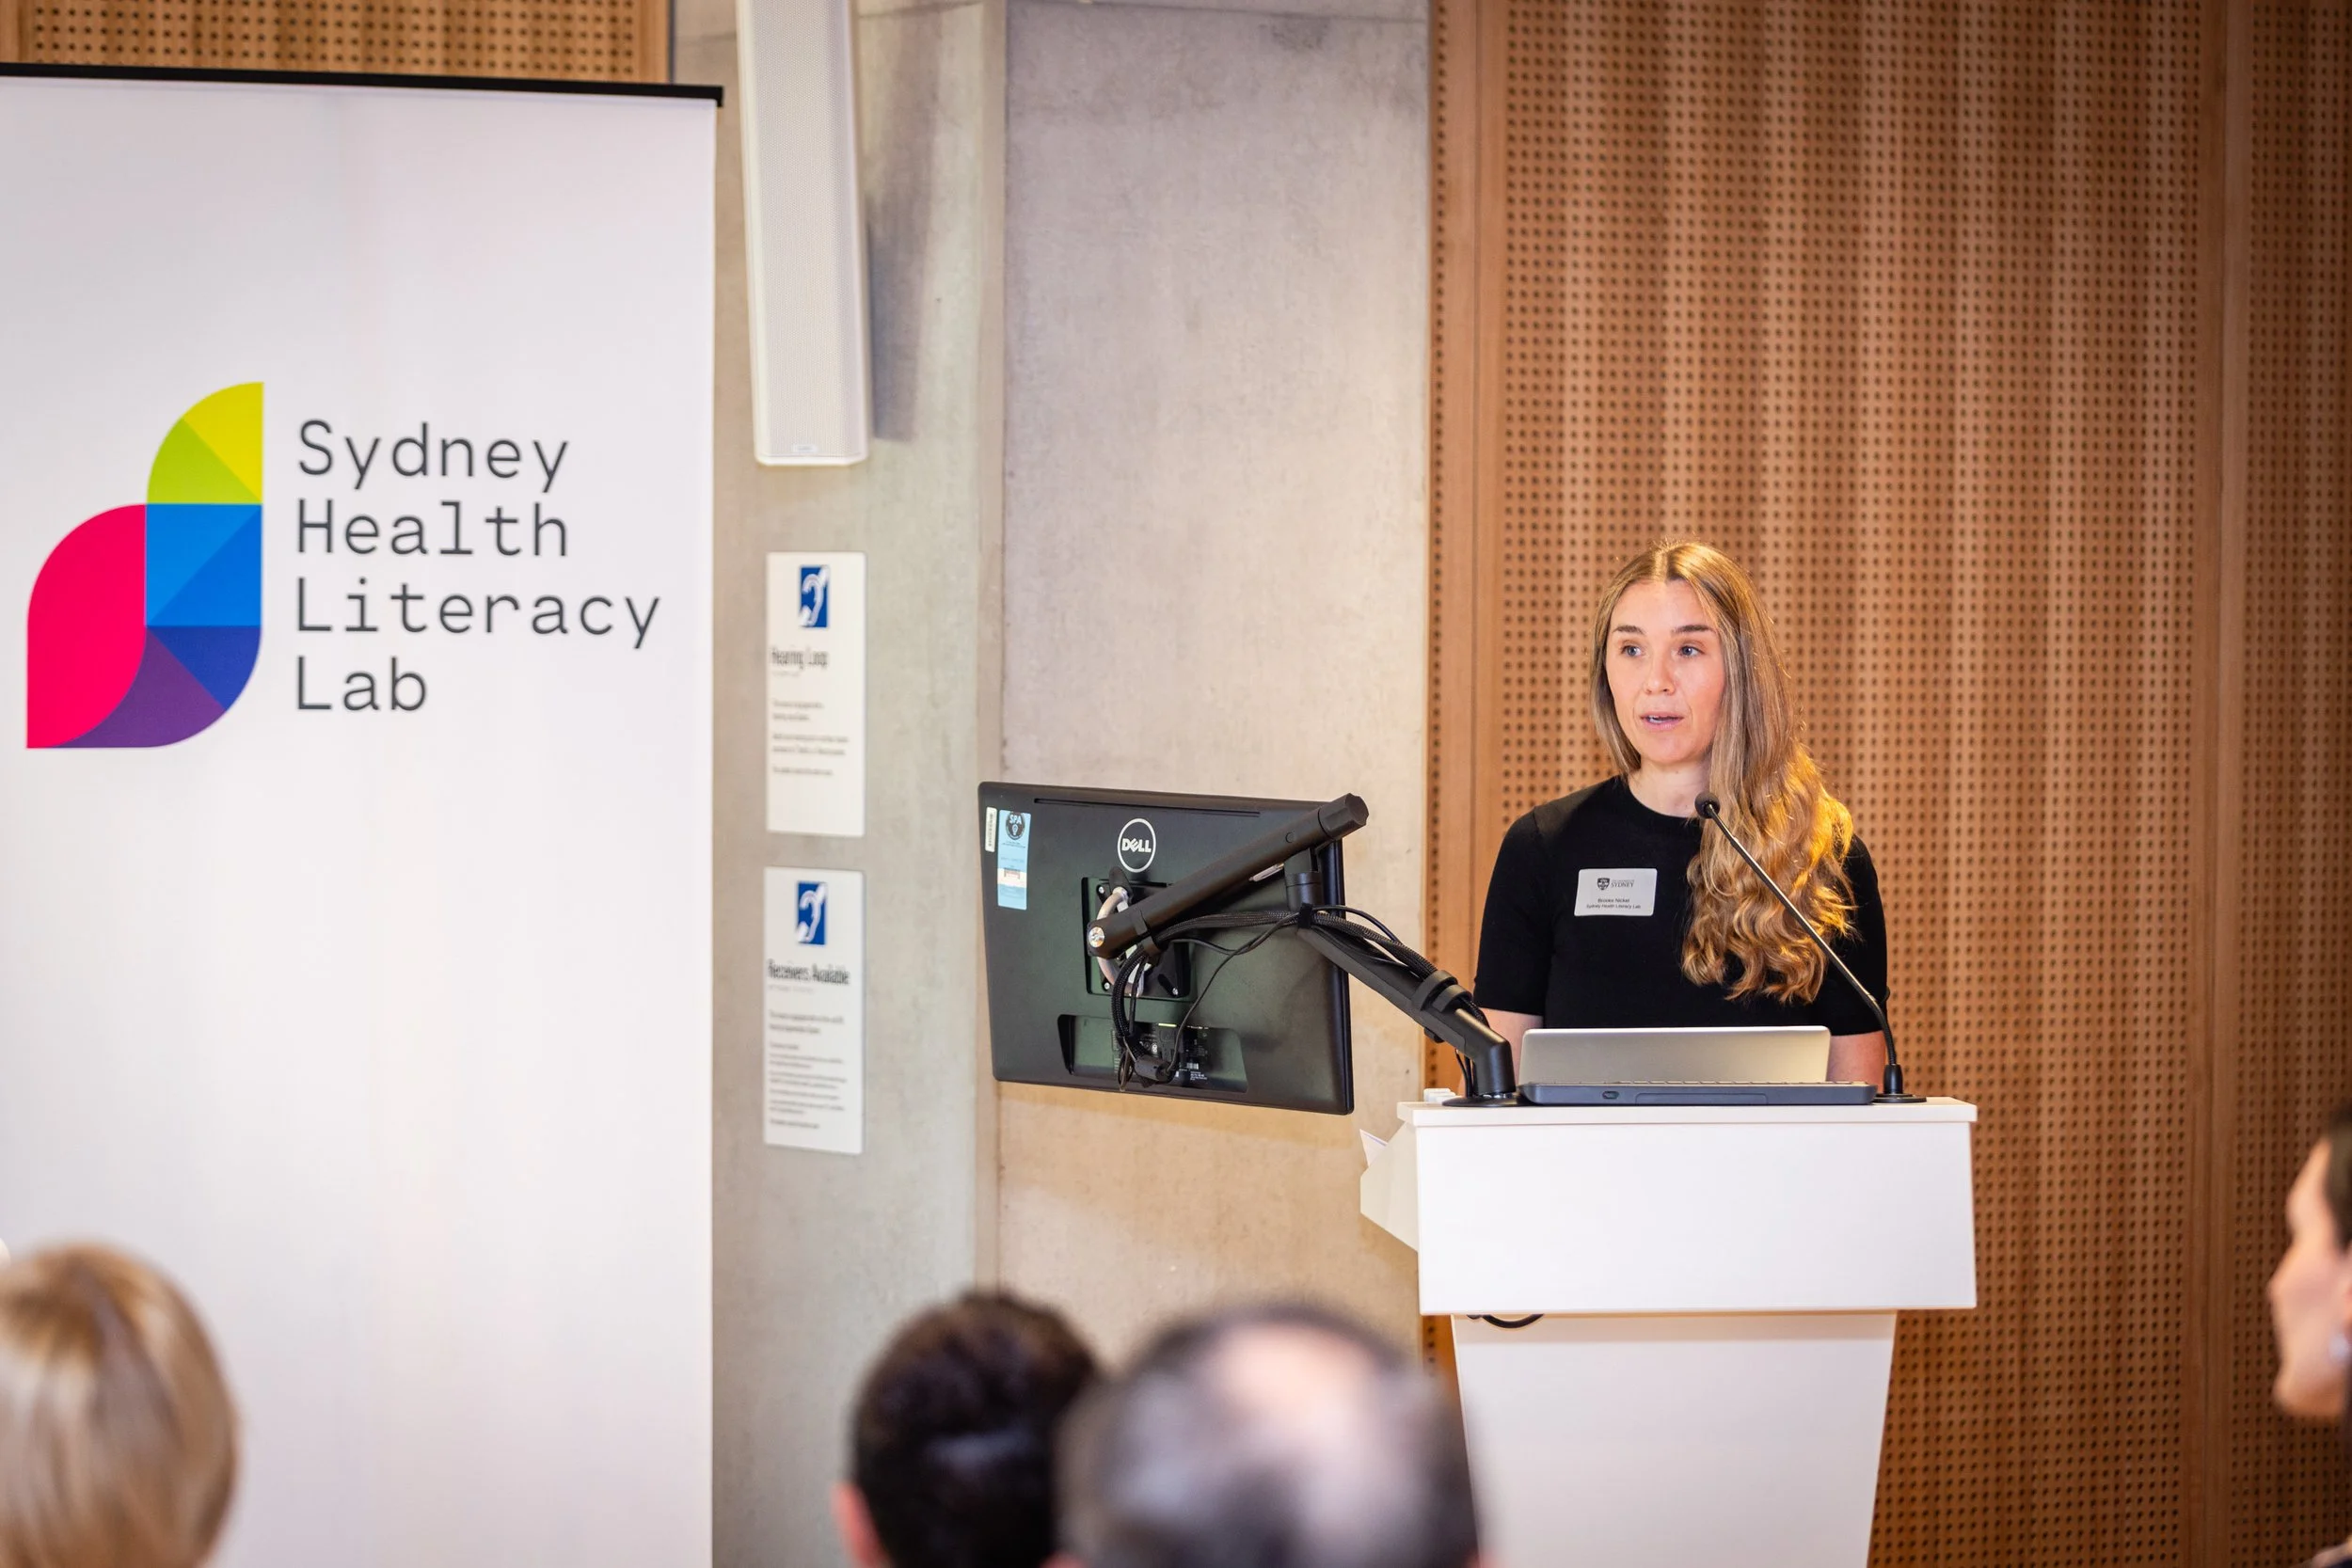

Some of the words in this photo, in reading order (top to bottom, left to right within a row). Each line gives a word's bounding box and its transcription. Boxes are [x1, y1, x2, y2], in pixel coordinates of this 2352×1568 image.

[298, 420, 569, 494] Sydney
[297, 499, 567, 557] Health
[297, 577, 660, 650] Literacy
[297, 656, 427, 712] Lab
[1009, 815, 1022, 825] SPA
[1121, 838, 1152, 852] DELL
